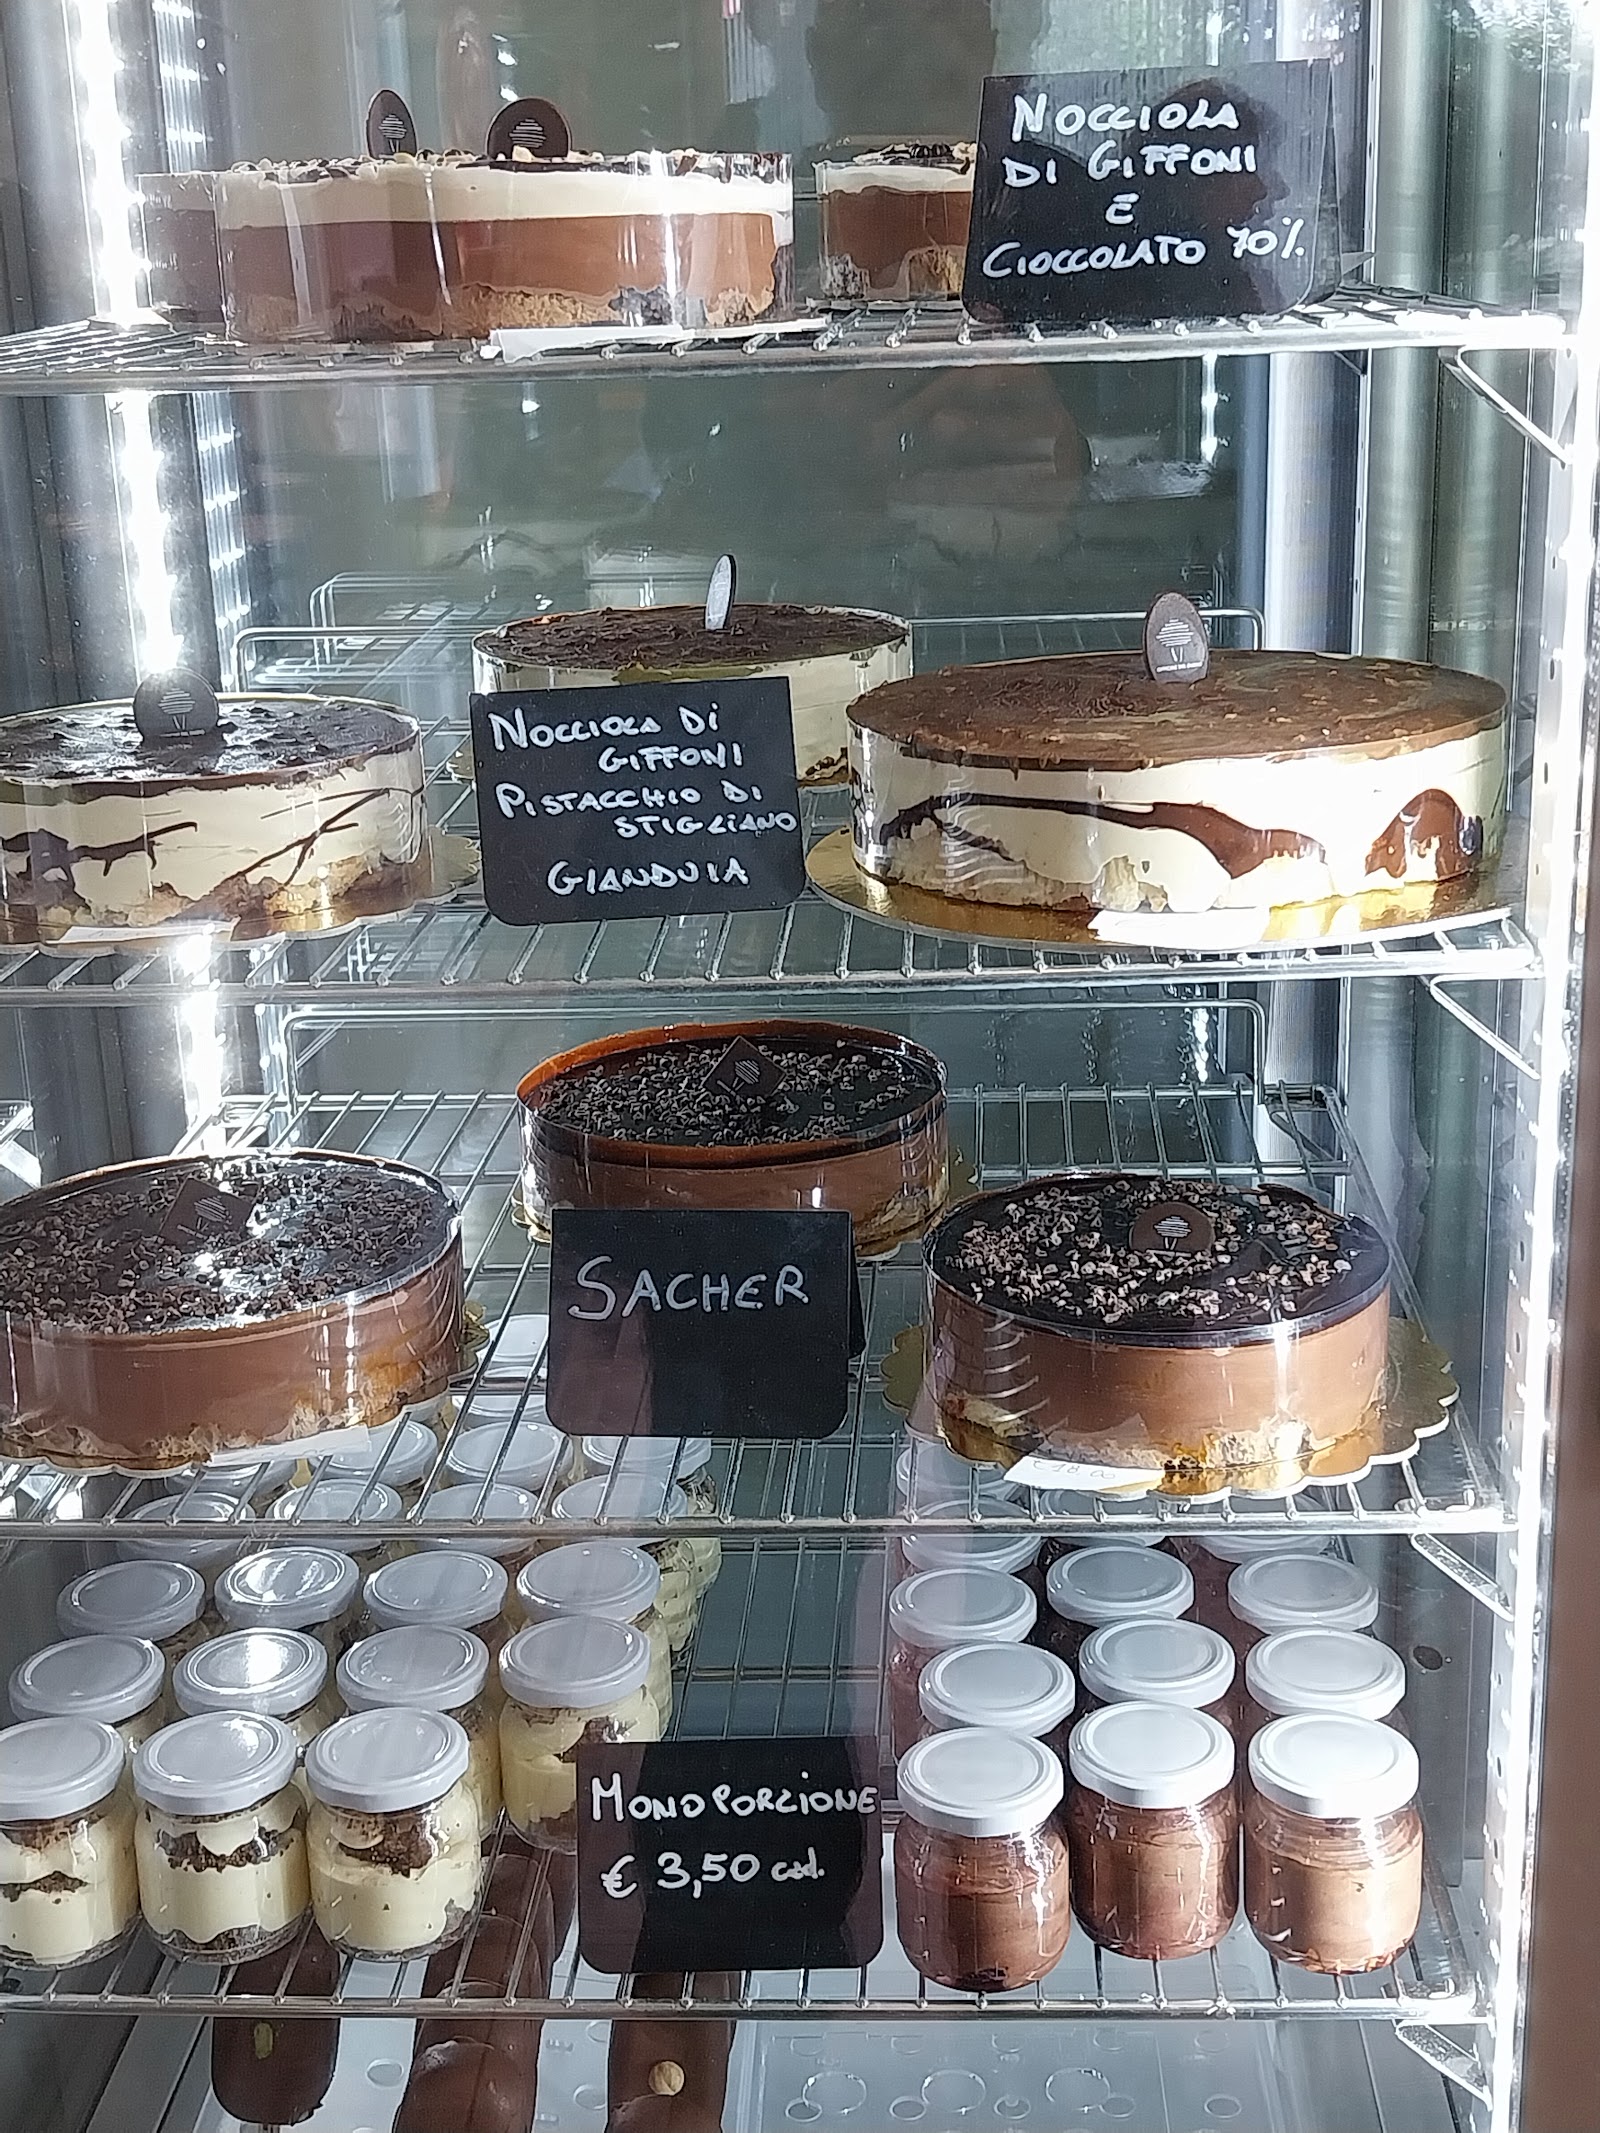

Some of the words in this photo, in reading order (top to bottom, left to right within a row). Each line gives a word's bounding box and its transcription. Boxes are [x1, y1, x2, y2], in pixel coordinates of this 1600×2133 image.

[1002, 156, 1058, 188] DI
[1087, 140, 1256, 180] GIFFONI
[1105, 193, 1140, 225] E
[982, 235, 1207, 278] CIOCCOLATO
[1226, 217, 1305, 260] 70%
[567, 1255, 810, 1321] SACHER
[600, 1854, 638, 1899] €
[656, 1851, 761, 1899] 3,50
